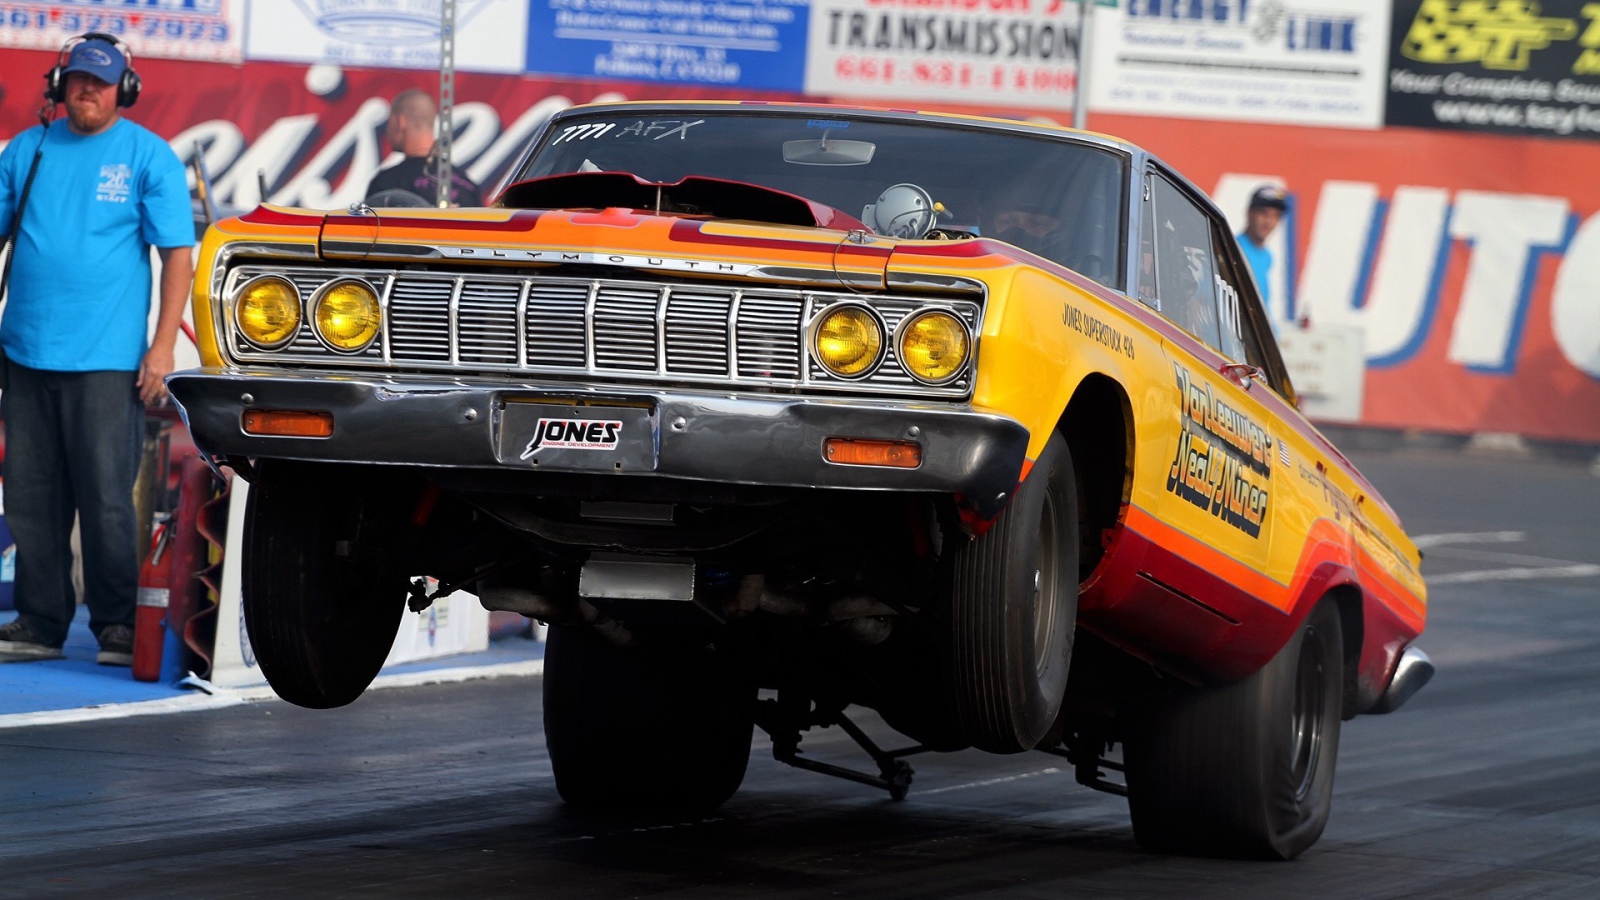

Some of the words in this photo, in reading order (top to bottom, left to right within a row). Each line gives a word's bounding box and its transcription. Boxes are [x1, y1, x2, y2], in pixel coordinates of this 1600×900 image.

[827, 11, 1079, 59] TRANSMISSION
[1285, 16, 1357, 53] LINK
[1391, 69, 1443, 93] Your
[1444, 73, 1553, 100] Complete
[552, 122, 617, 145] 7771
[615, 119, 705, 140] AFX
[96, 194, 127, 204] STAFF
[458, 248, 735, 271] PLYMOUTH
[1062, 302, 1083, 334] JONES
[1123, 335, 1135, 360] 426
[521, 419, 622, 458] JONES
[1167, 430, 1213, 508] Neal
[1214, 455, 1268, 534] Miner
